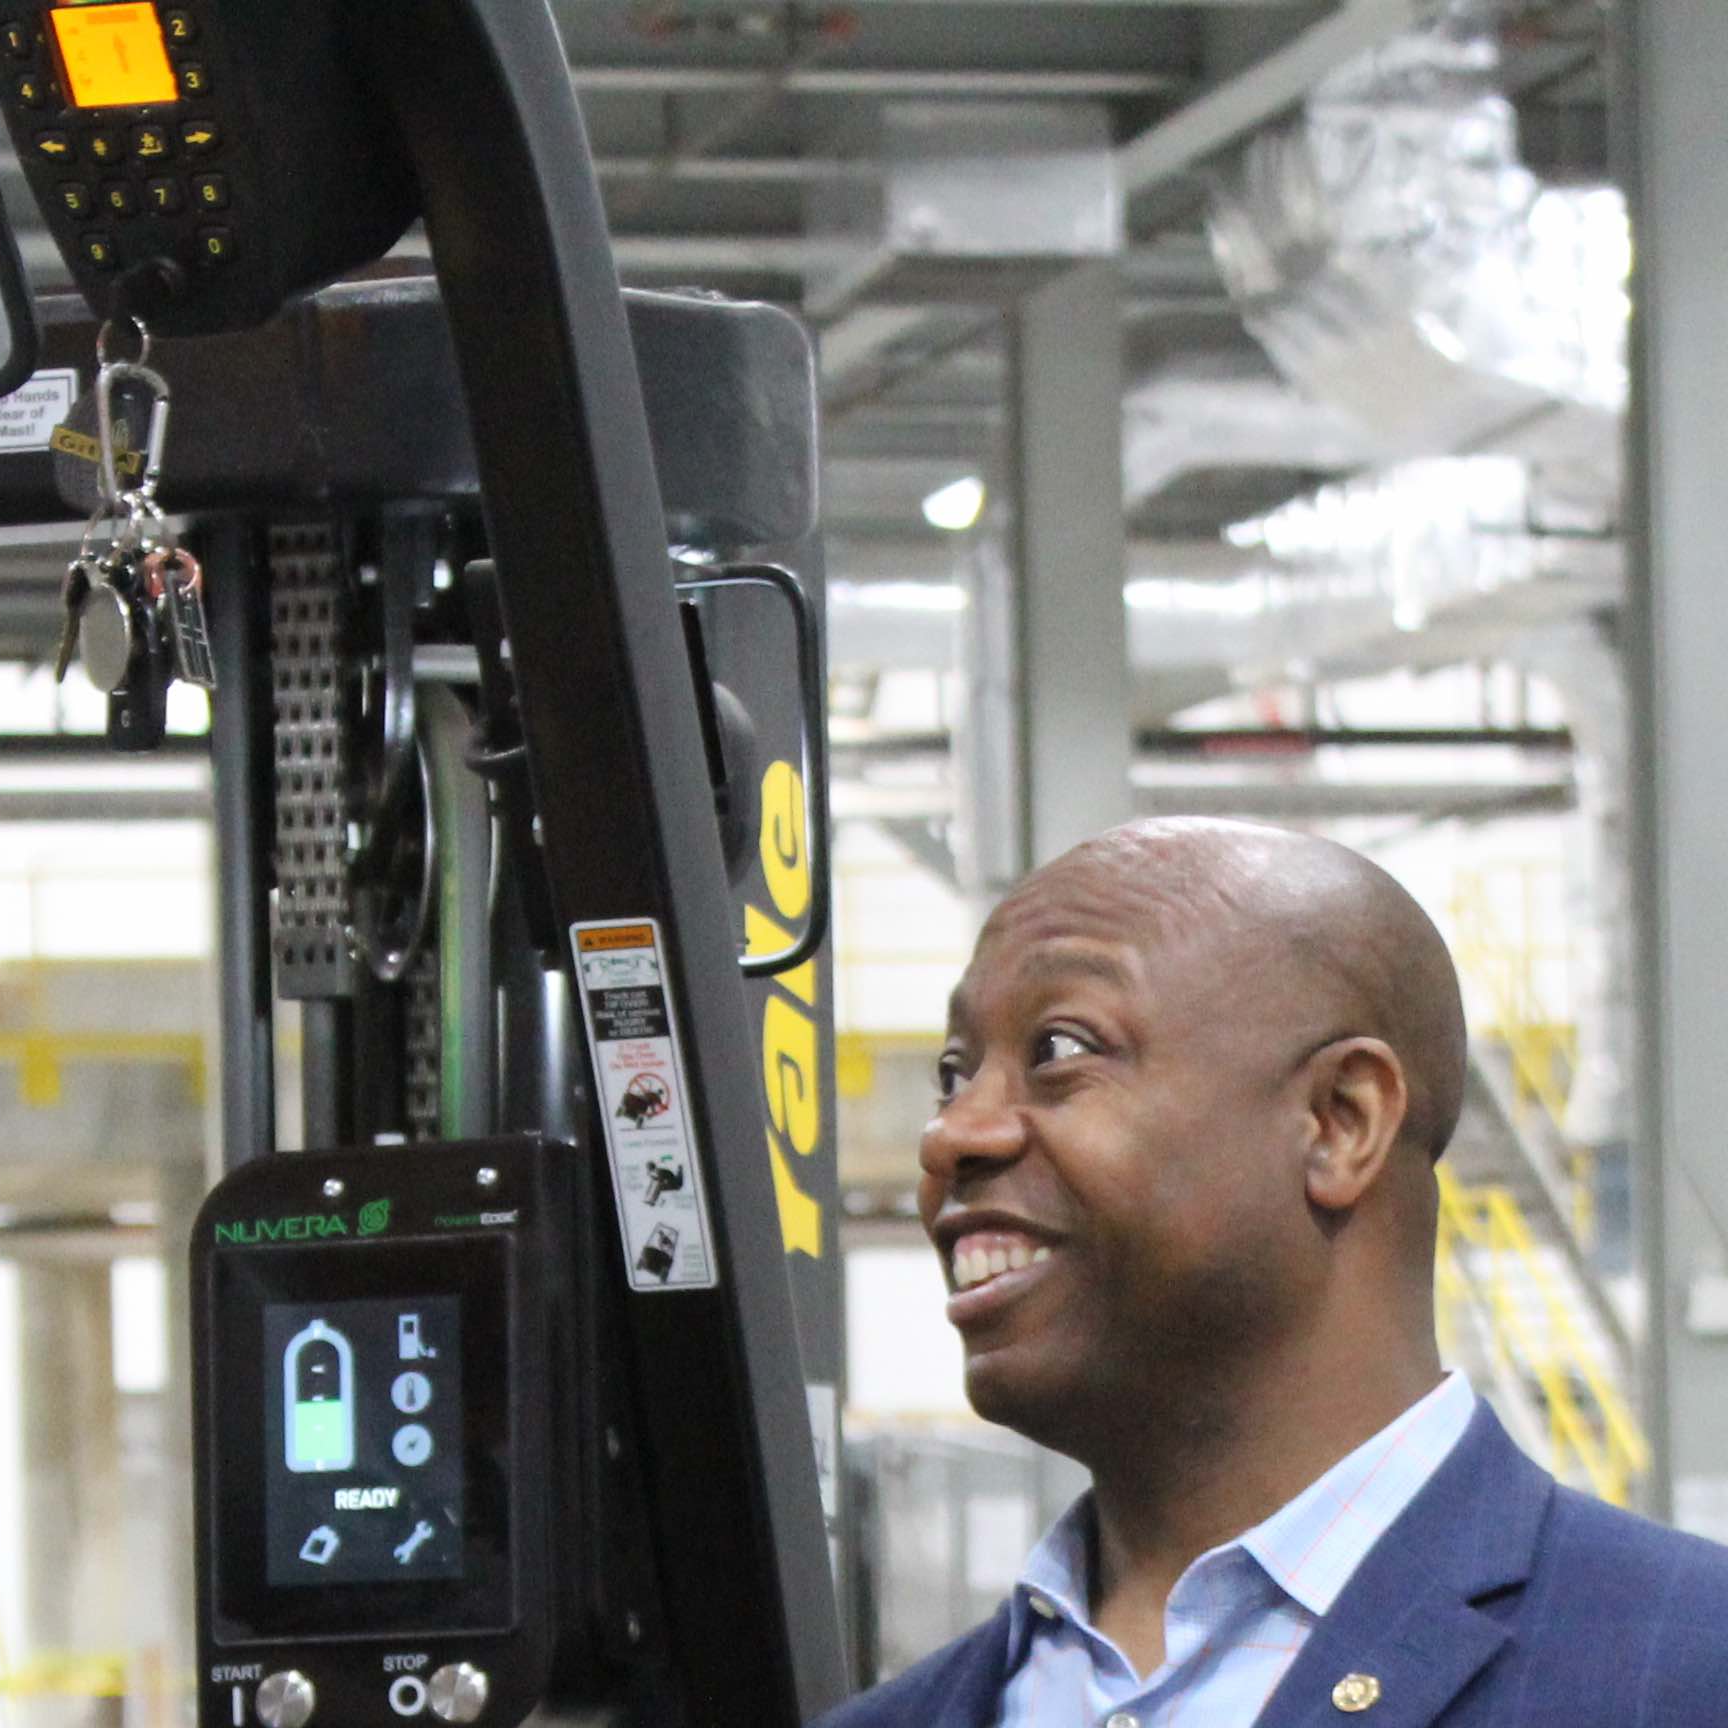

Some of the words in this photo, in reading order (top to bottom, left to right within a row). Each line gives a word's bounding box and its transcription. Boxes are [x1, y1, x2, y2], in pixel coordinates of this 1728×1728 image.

[172, 19, 186, 37] 2
[8, 31, 18, 48] 1
[186, 72, 200, 89] 3
[22, 83, 33, 98] 4
[65, 193, 80, 208] 5
[111, 192, 124, 207] 6
[154, 189, 165, 205] 7
[202, 185, 216, 201] 8
[91, 243, 104, 260] 9
[208, 238, 221, 254] 0
[14, 389, 59, 403] Hands
[30, 406, 46, 419] of
[215, 1214, 347, 1243] NUVERA
[334, 1488, 400, 1510] READY
[211, 1663, 264, 1683] START
[383, 1655, 429, 1673] STOP
